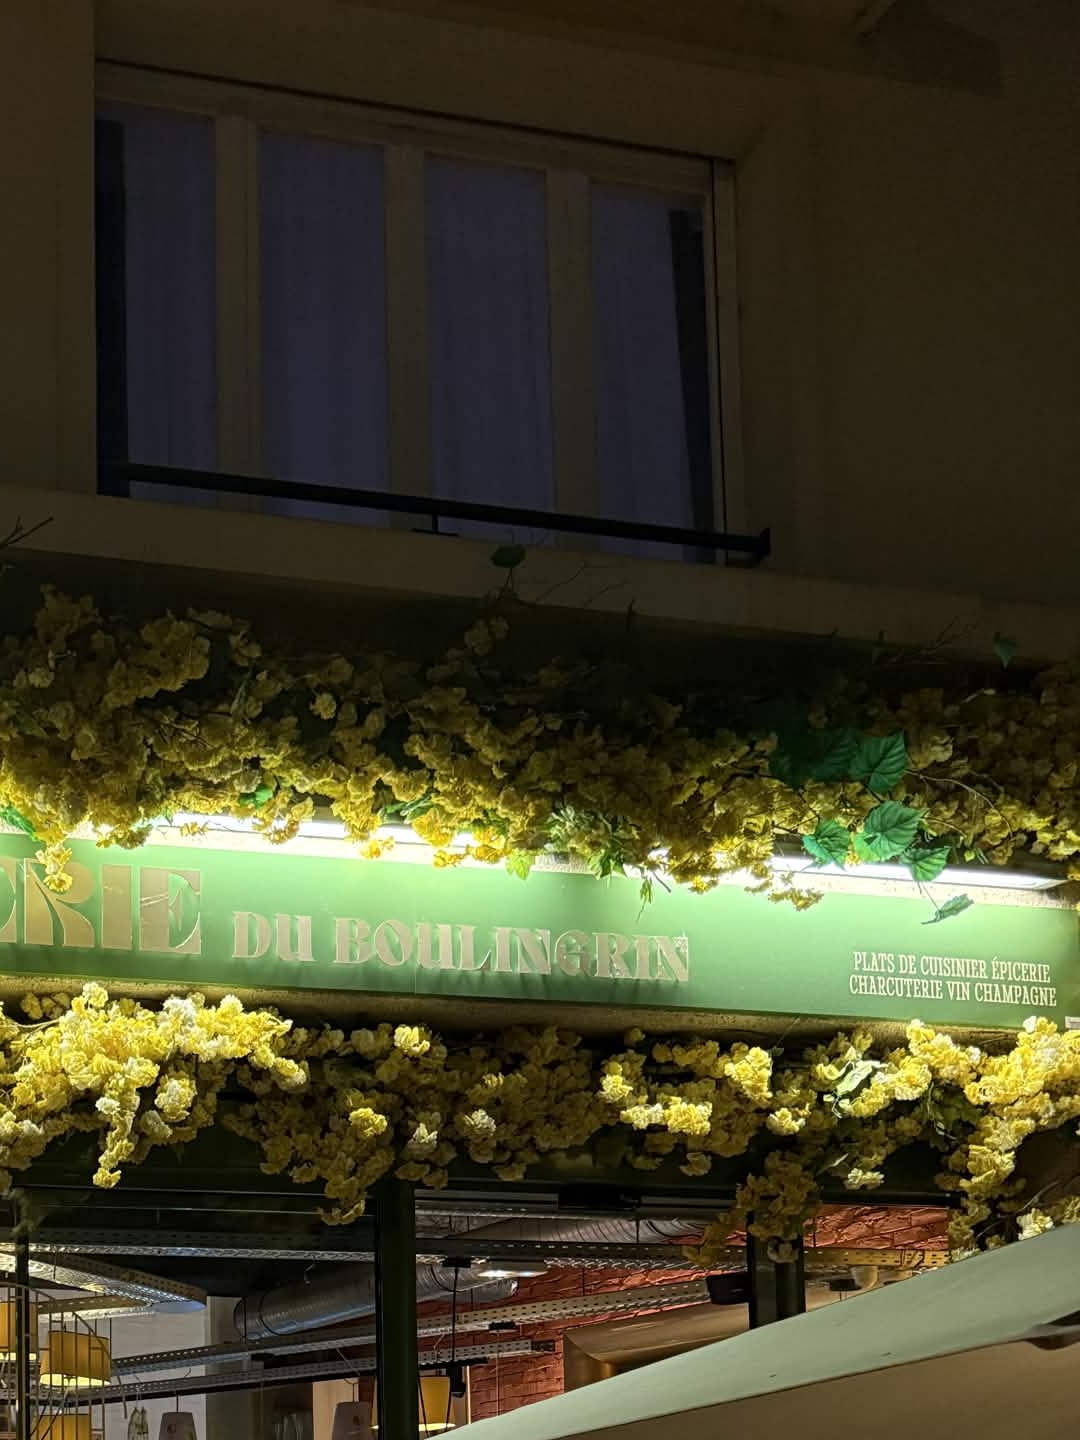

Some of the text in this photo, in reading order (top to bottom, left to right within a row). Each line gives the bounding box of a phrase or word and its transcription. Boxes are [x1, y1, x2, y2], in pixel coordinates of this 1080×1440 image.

[232, 911, 315, 962] DU
[334, 916, 690, 982] BOULINGRIN
[853, 951, 1051, 983] PLATS DE CUISINIER ÉPICERIE
[849, 975, 1057, 1007] CHARCUTERIE VIN CHAMPAGNE
